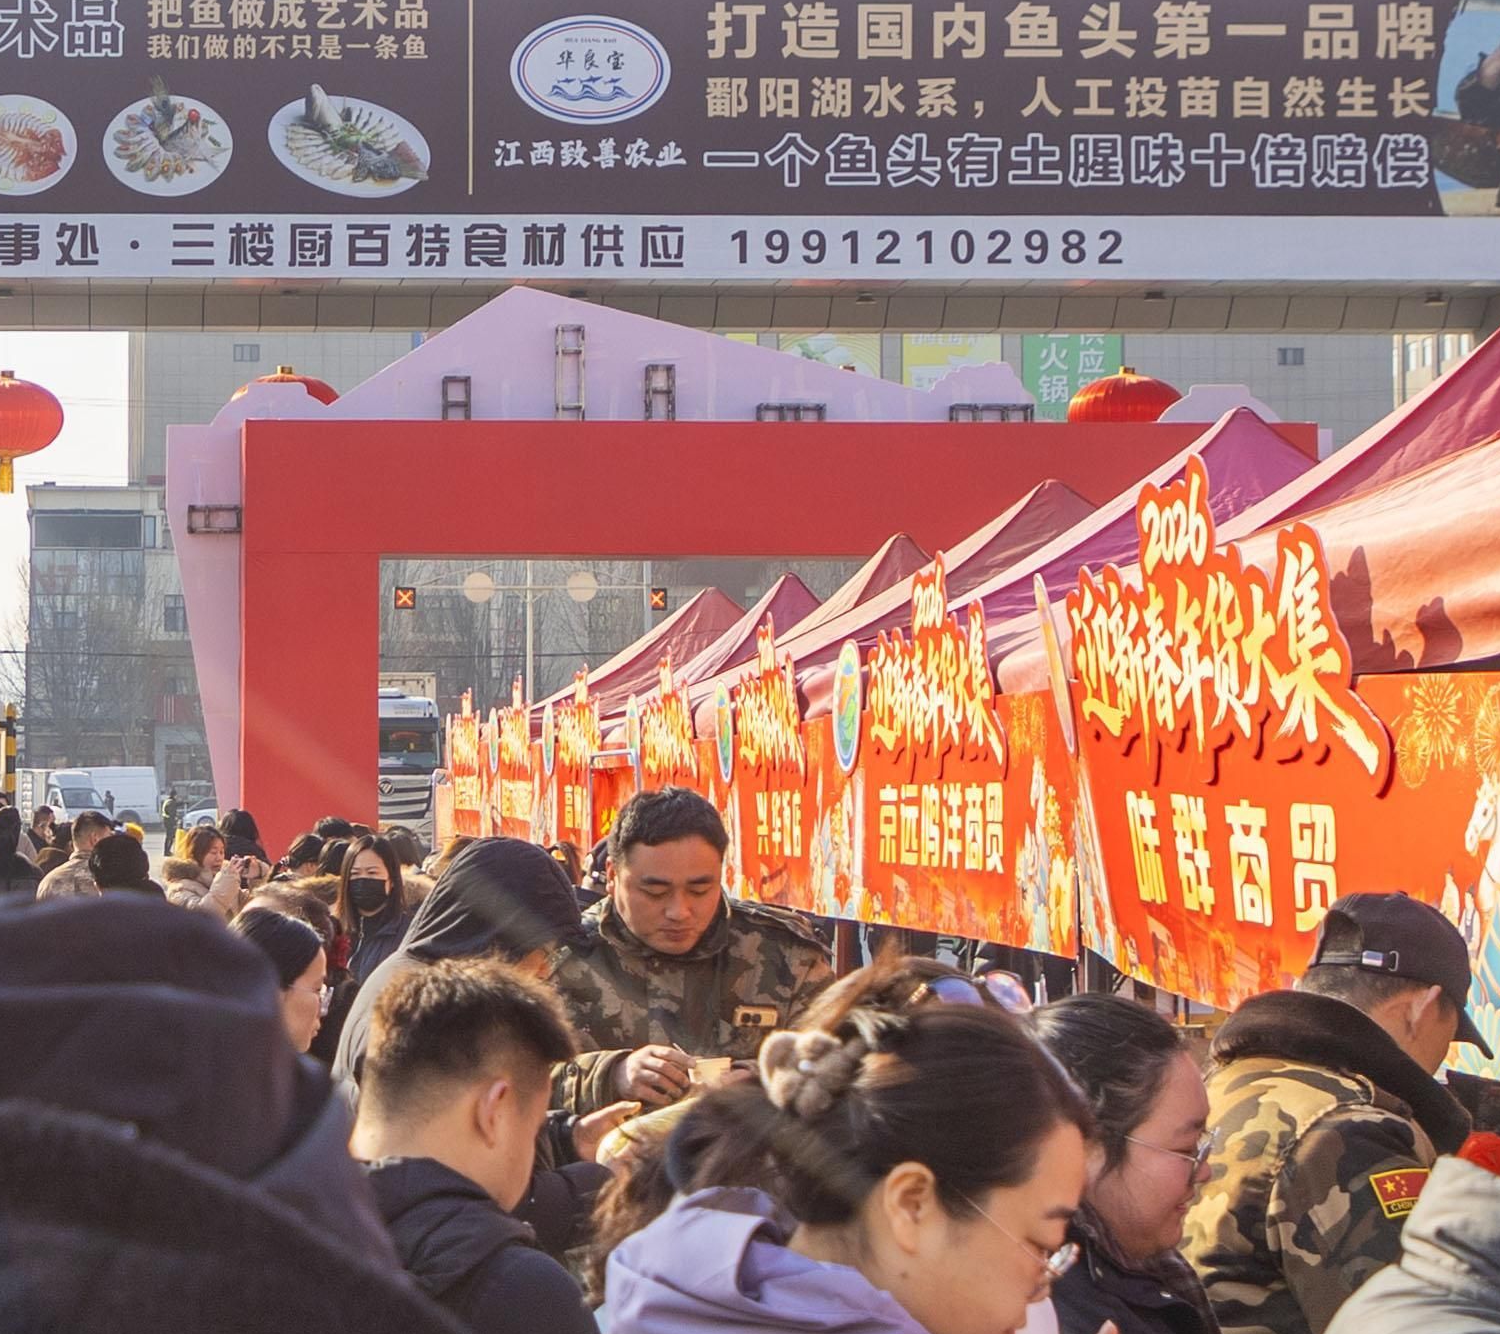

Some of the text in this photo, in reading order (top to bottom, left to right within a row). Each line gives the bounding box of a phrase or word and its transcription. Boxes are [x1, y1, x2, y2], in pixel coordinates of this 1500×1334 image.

[146, 34, 429, 60] 我们做的不只是一条鱼
[556, 49, 625, 71] 华良宝
[706, 0, 1436, 61] 打造国内鱼头第一品牌
[494, 137, 687, 169] 江西致善农业
[703, 132, 1430, 188] 一个鱼头有土腥味十倍赔偿
[730, 228, 1123, 264] 19912102982
[1038, 334, 1070, 404] 火锅
[1140, 473, 1209, 571] 2026
[869, 610, 1003, 766] 迎新春年货大集
[1072, 541, 1380, 777] 迎新春年货大集
[1125, 789, 1340, 934] 味群商贸
